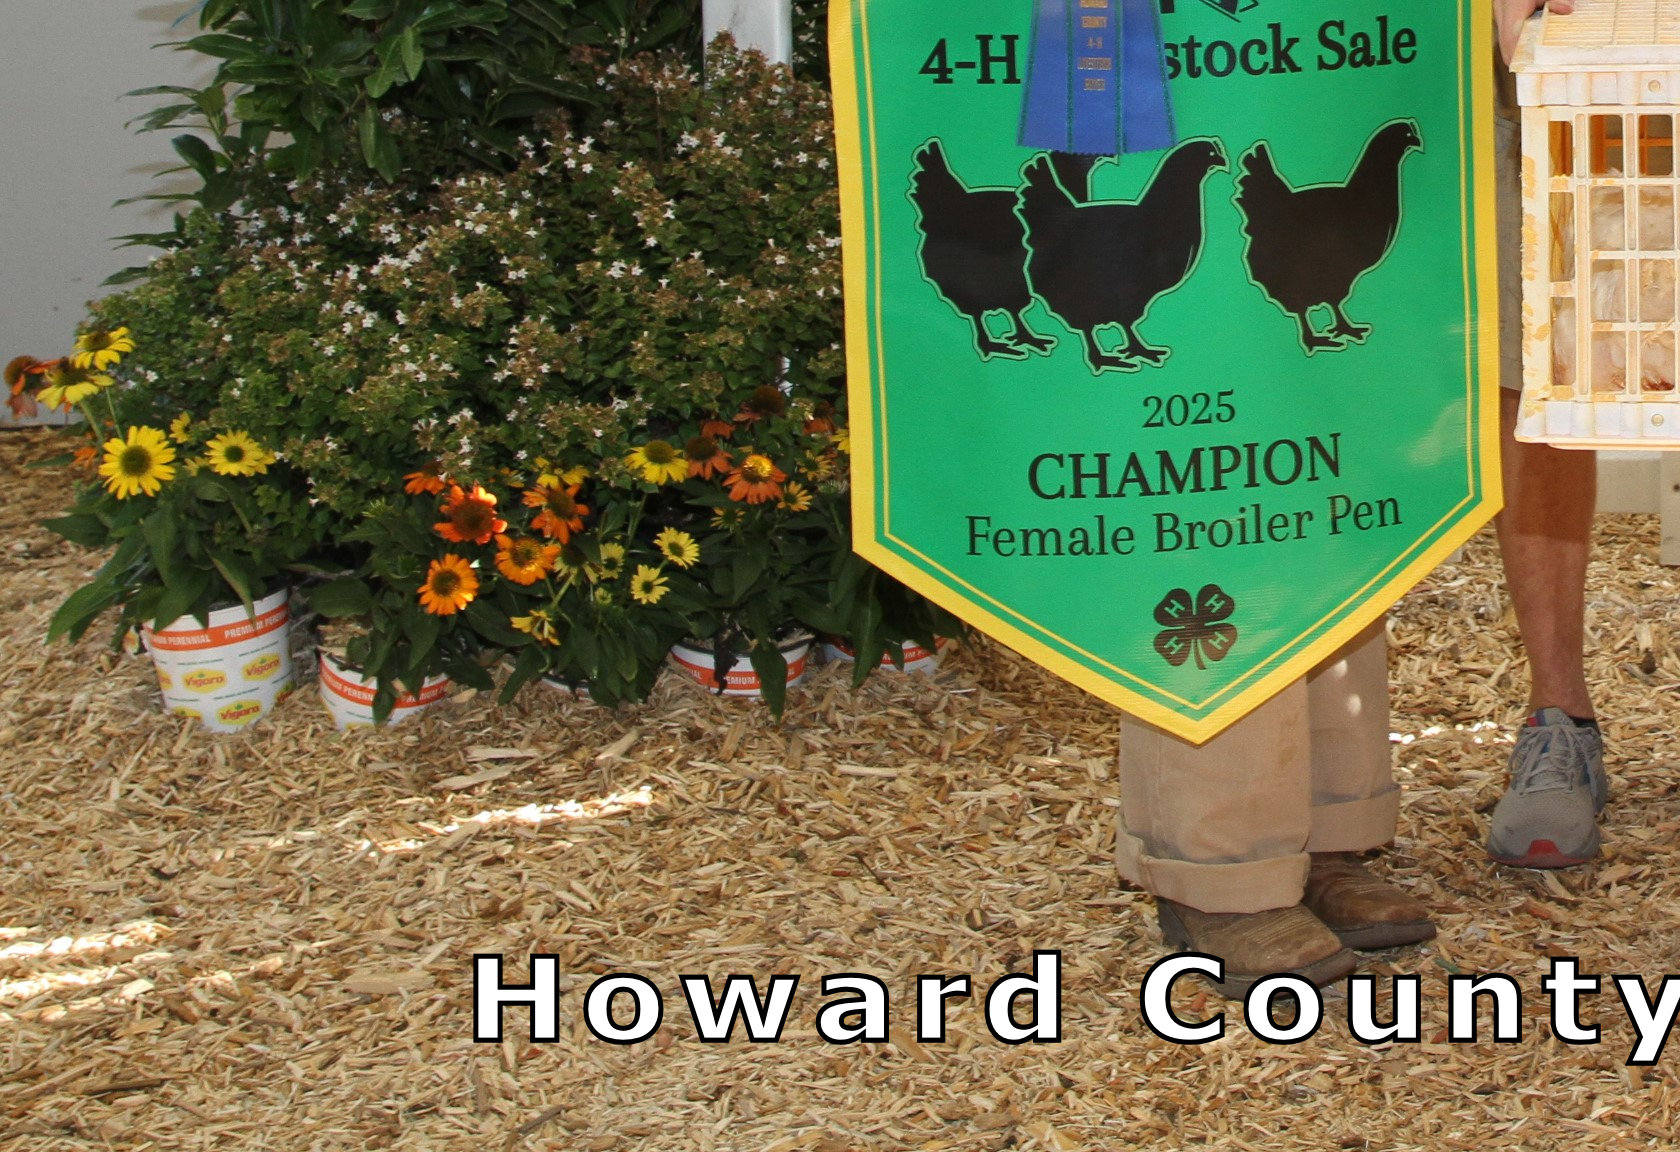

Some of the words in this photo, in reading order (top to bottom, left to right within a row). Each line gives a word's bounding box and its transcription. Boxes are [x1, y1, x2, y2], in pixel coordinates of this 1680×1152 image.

[919, 34, 1021, 85] 4-H
[1164, 22, 1302, 80] stock
[1317, 15, 1418, 71] Sale
[1142, 390, 1237, 429] 2025
[1028, 433, 1342, 501] CHAMPION
[965, 514, 1136, 556] Female
[1153, 503, 1314, 553] Broiler
[1328, 495, 1403, 536] Pen
[168, 634, 212, 646] PERENNIAL
[245, 659, 280, 677] Vigoro
[185, 674, 225, 688] Vigoro
[725, 677, 755, 685] EMIUM
[342, 684, 374, 701] PERENN
[219, 704, 261, 720] Vigoro
